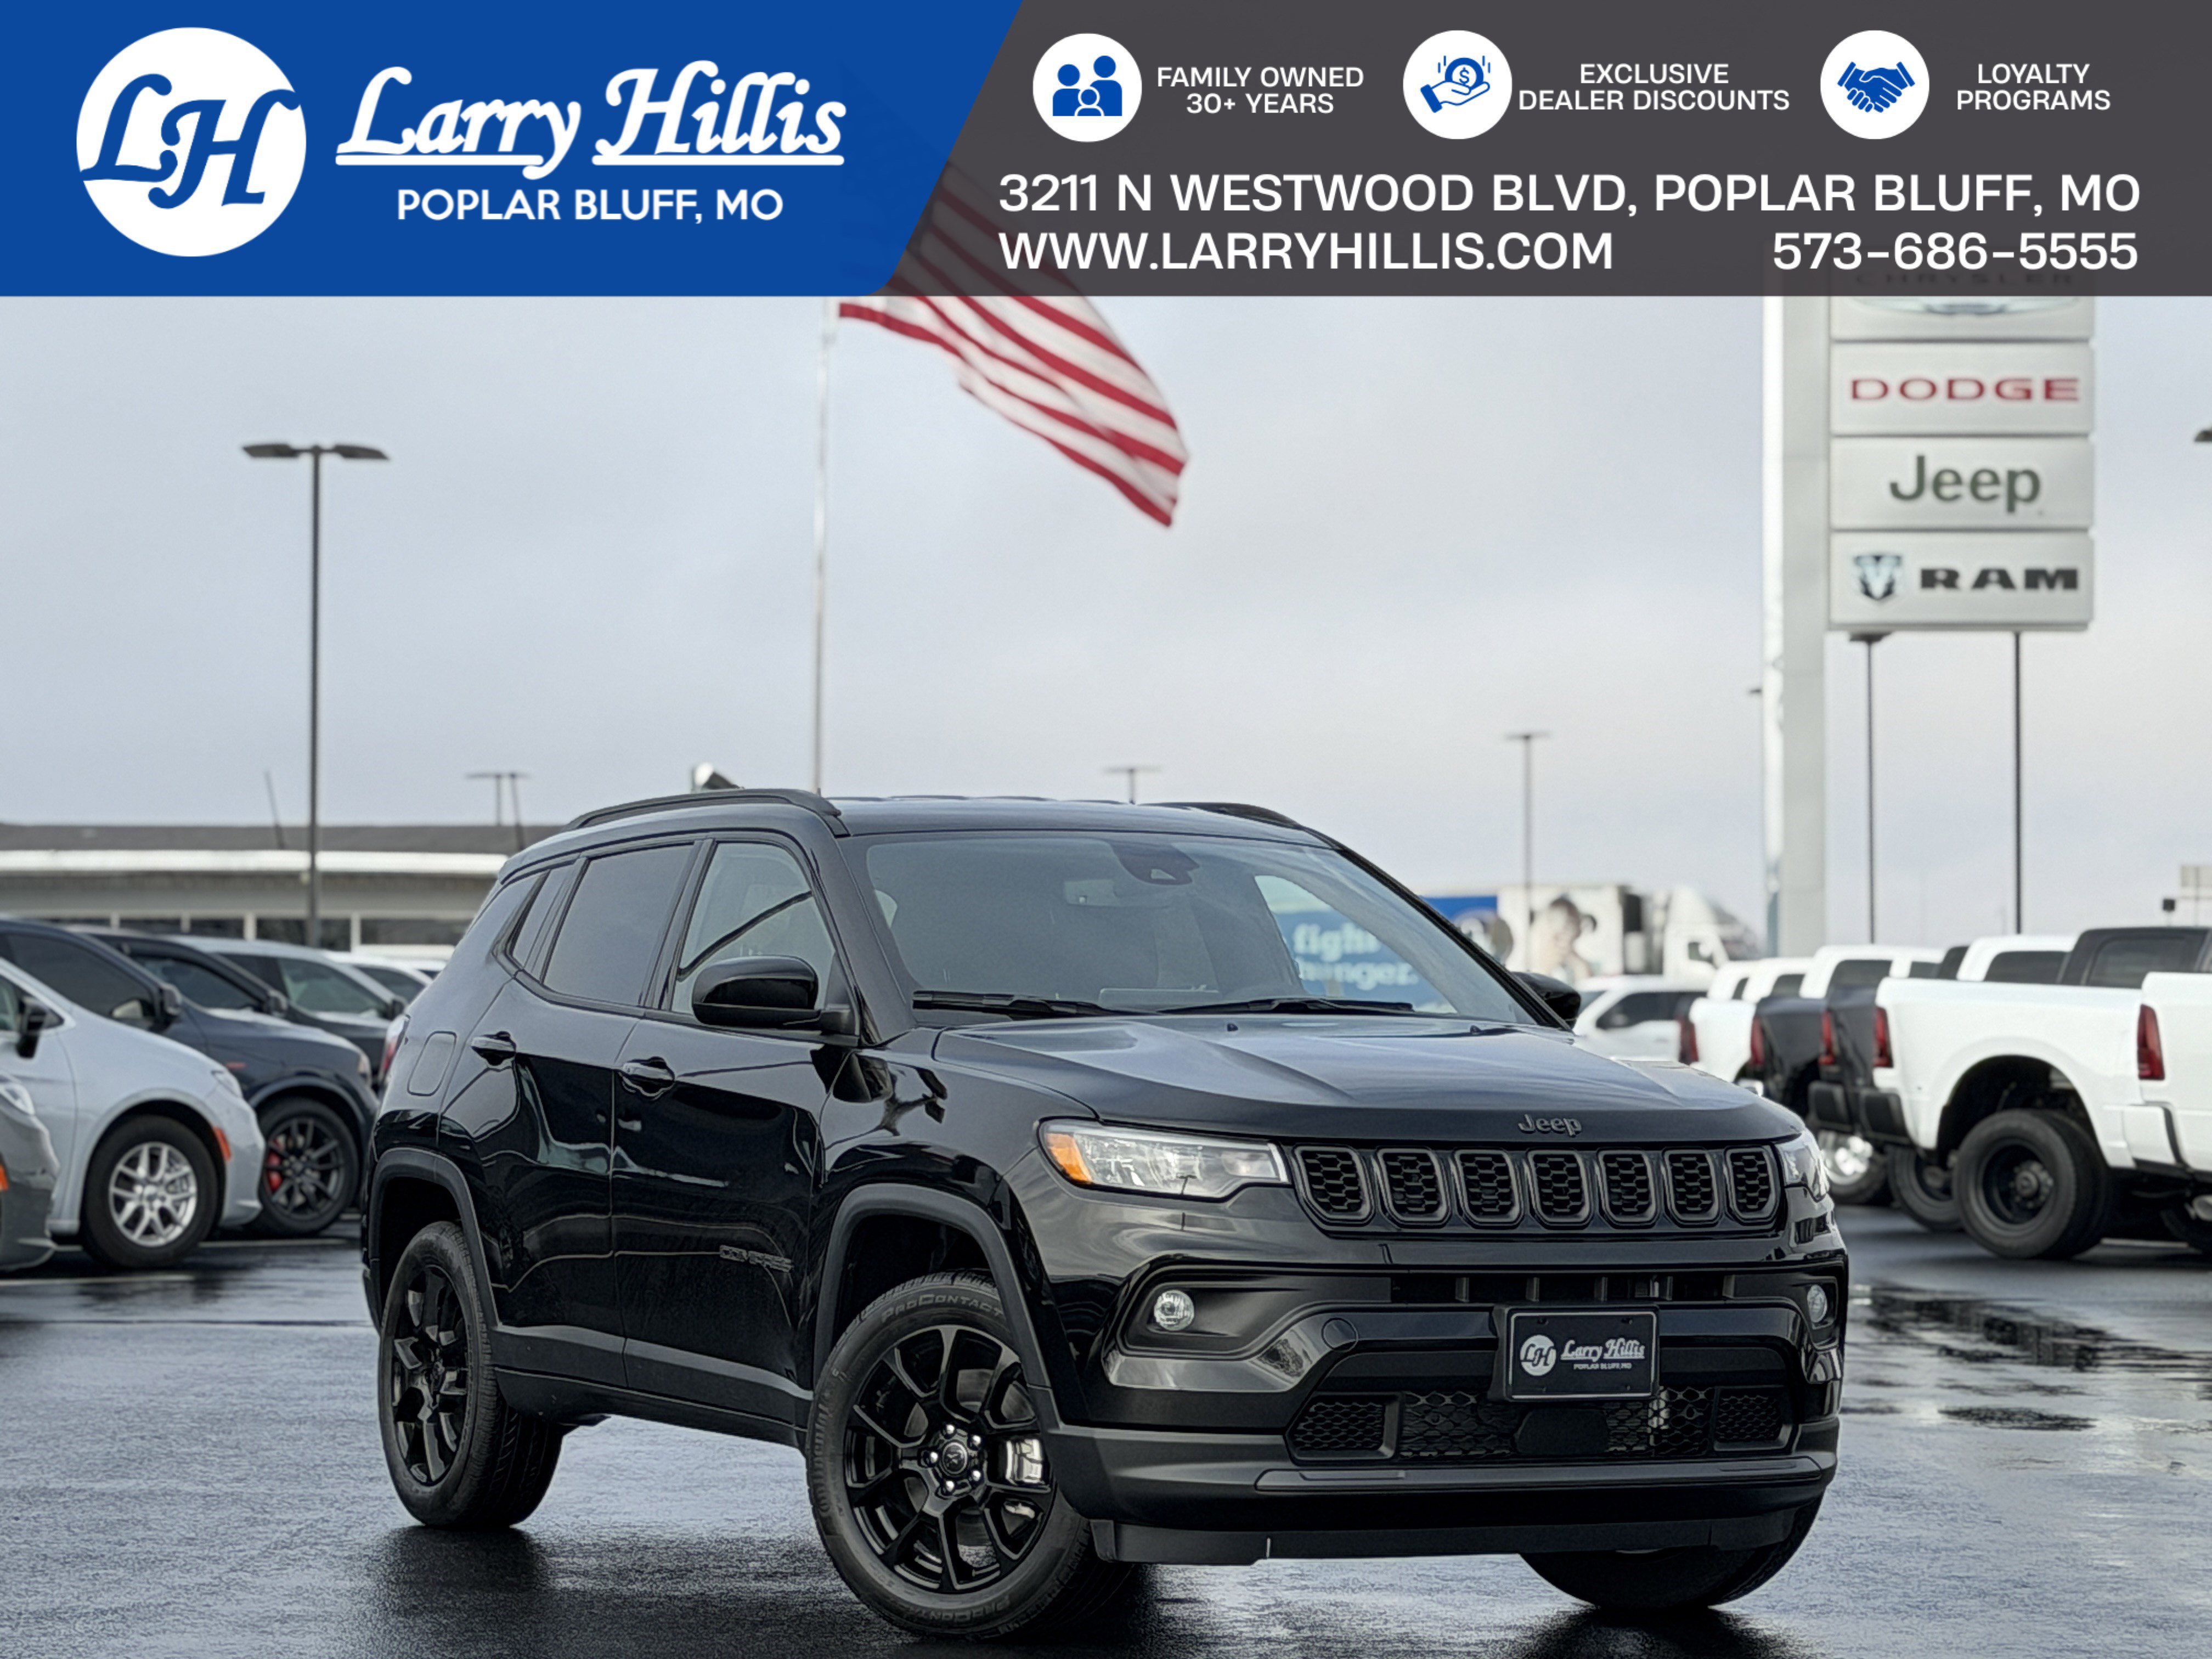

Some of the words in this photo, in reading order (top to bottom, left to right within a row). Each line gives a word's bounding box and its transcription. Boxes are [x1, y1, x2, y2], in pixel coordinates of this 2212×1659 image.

[1851, 377, 2079, 402] DODGE
[1889, 455, 2041, 514] Jeep
[1920, 568, 2079, 591] RAM
[1518, 1114, 1582, 1137] Jeep
[1560, 1339, 1603, 1362] Larry
[1602, 1338, 1646, 1360] Hillis
